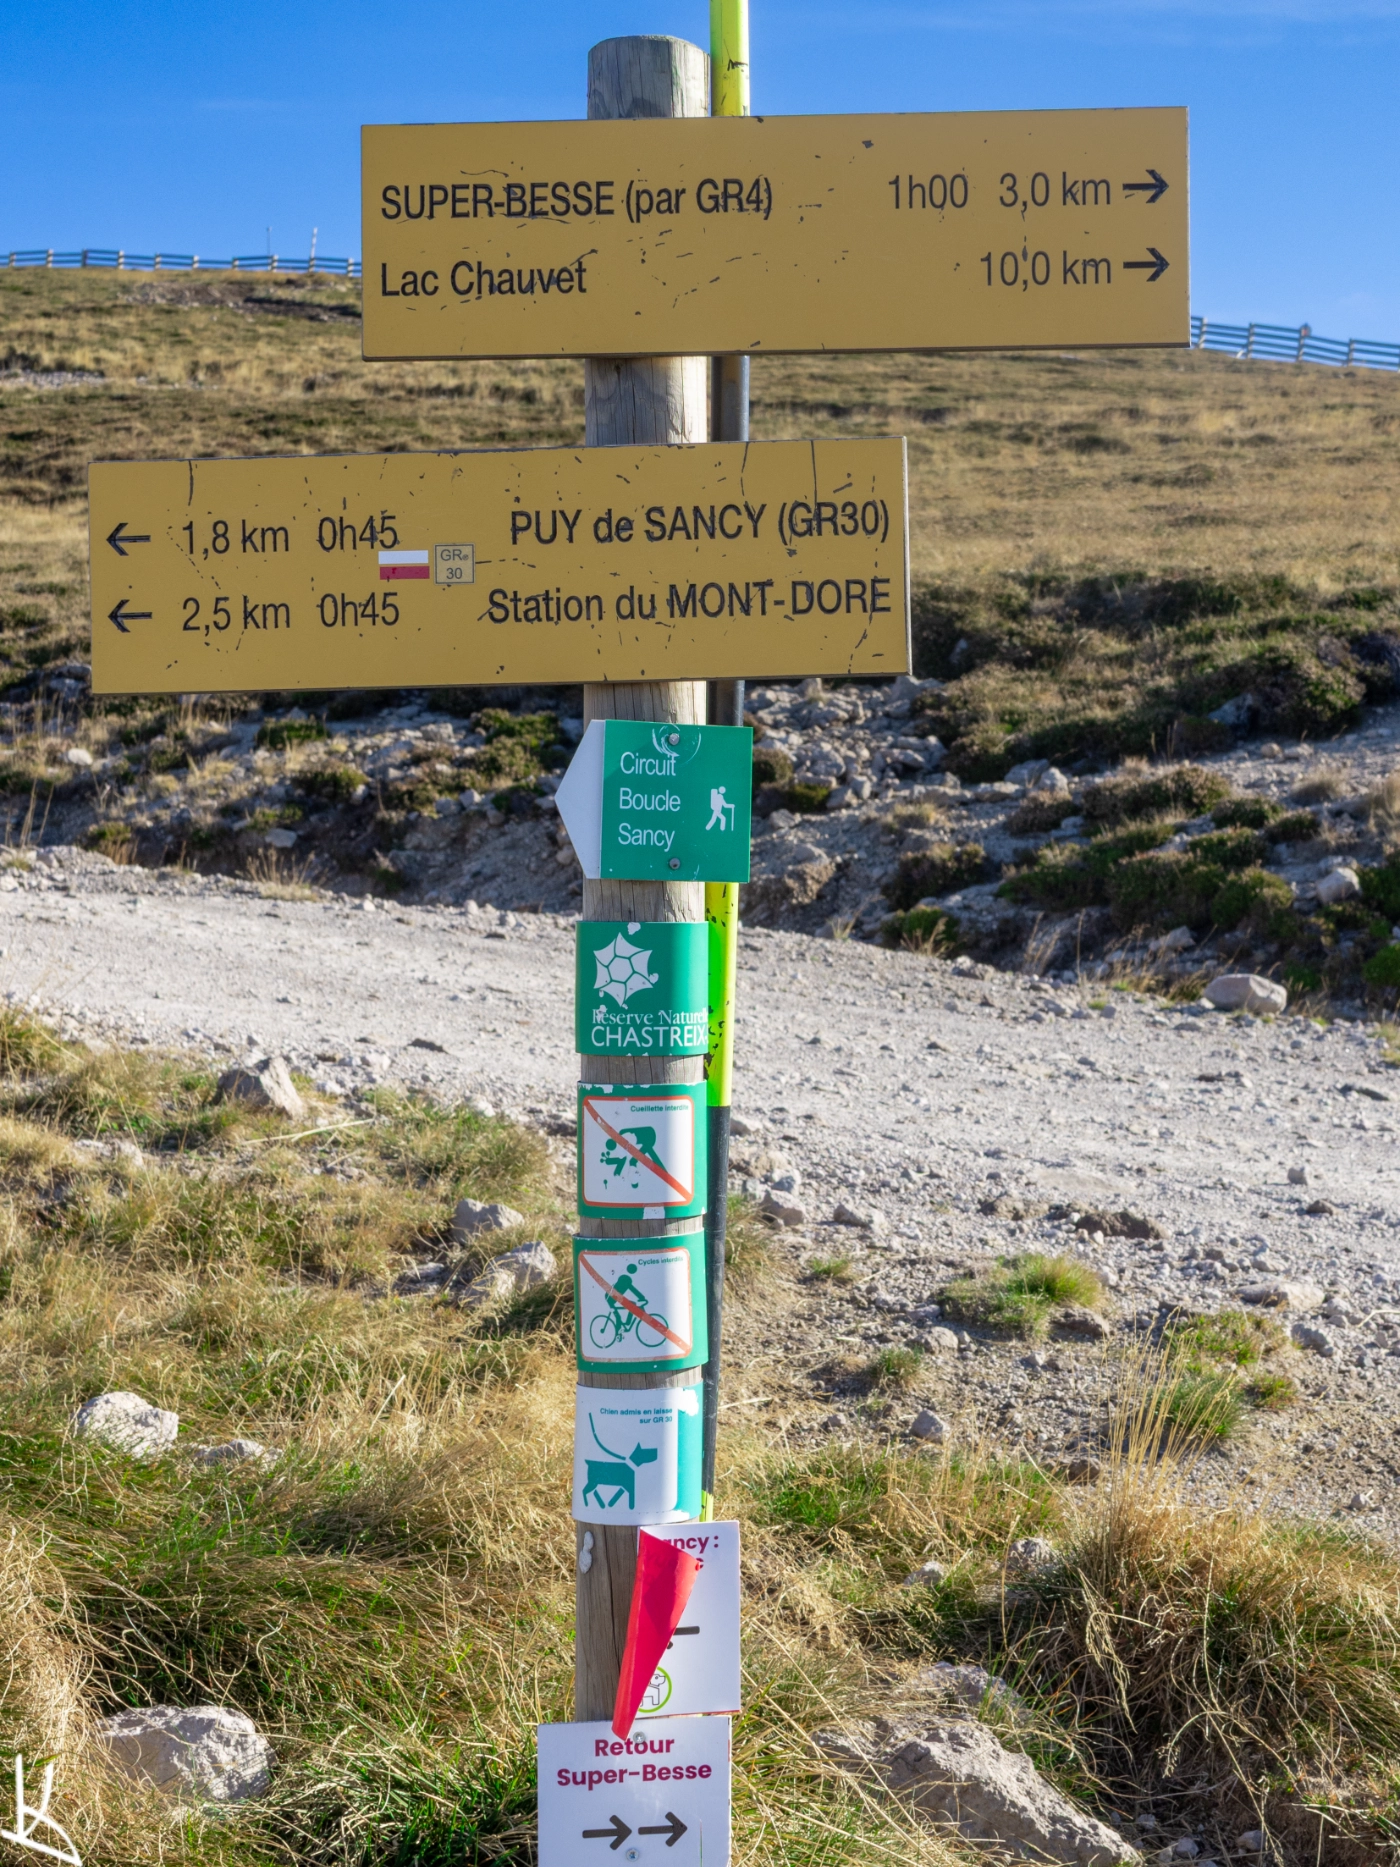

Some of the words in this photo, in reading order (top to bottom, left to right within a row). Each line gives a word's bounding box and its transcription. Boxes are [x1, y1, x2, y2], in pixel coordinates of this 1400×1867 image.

[381, 180, 614, 220] SUPER-BESSE
[626, 180, 686, 223] (par
[697, 177, 773, 221] GR4)
[888, 174, 969, 210] 1h00
[999, 172, 1051, 213] 3,0
[1062, 171, 1112, 206] km
[381, 261, 439, 297] Lac
[450, 259, 587, 296] Chauvet
[980, 251, 1051, 292] 10,0
[1062, 250, 1112, 285] km
[182, 520, 230, 560] 1,8
[241, 518, 290, 554] km
[317, 515, 398, 552] 0h45
[511, 509, 583, 545] PUY
[592, 508, 634, 543] de
[644, 503, 767, 542] SANCY
[777, 499, 889, 545] (GR30)
[446, 567, 463, 579] 30
[182, 596, 231, 637] 2,5
[242, 595, 291, 630] km
[319, 592, 400, 628] 0h45
[488, 587, 604, 623] Station
[615, 586, 656, 620] du
[668, 577, 892, 619] MONT-DORE
[620, 751, 677, 776] Circuit
[619, 787, 681, 812] Boucle
[618, 822, 675, 853] Sancy
[630, 1105, 664, 1113] Cueillette
[664, 1104, 689, 1112] interdite
[638, 1258, 660, 1266] Cycles
[600, 1407, 619, 1415] Chien
[620, 1407, 642, 1415] admis
[594, 1738, 675, 1757] Retour
[556, 1763, 713, 1791] Super-Besse
